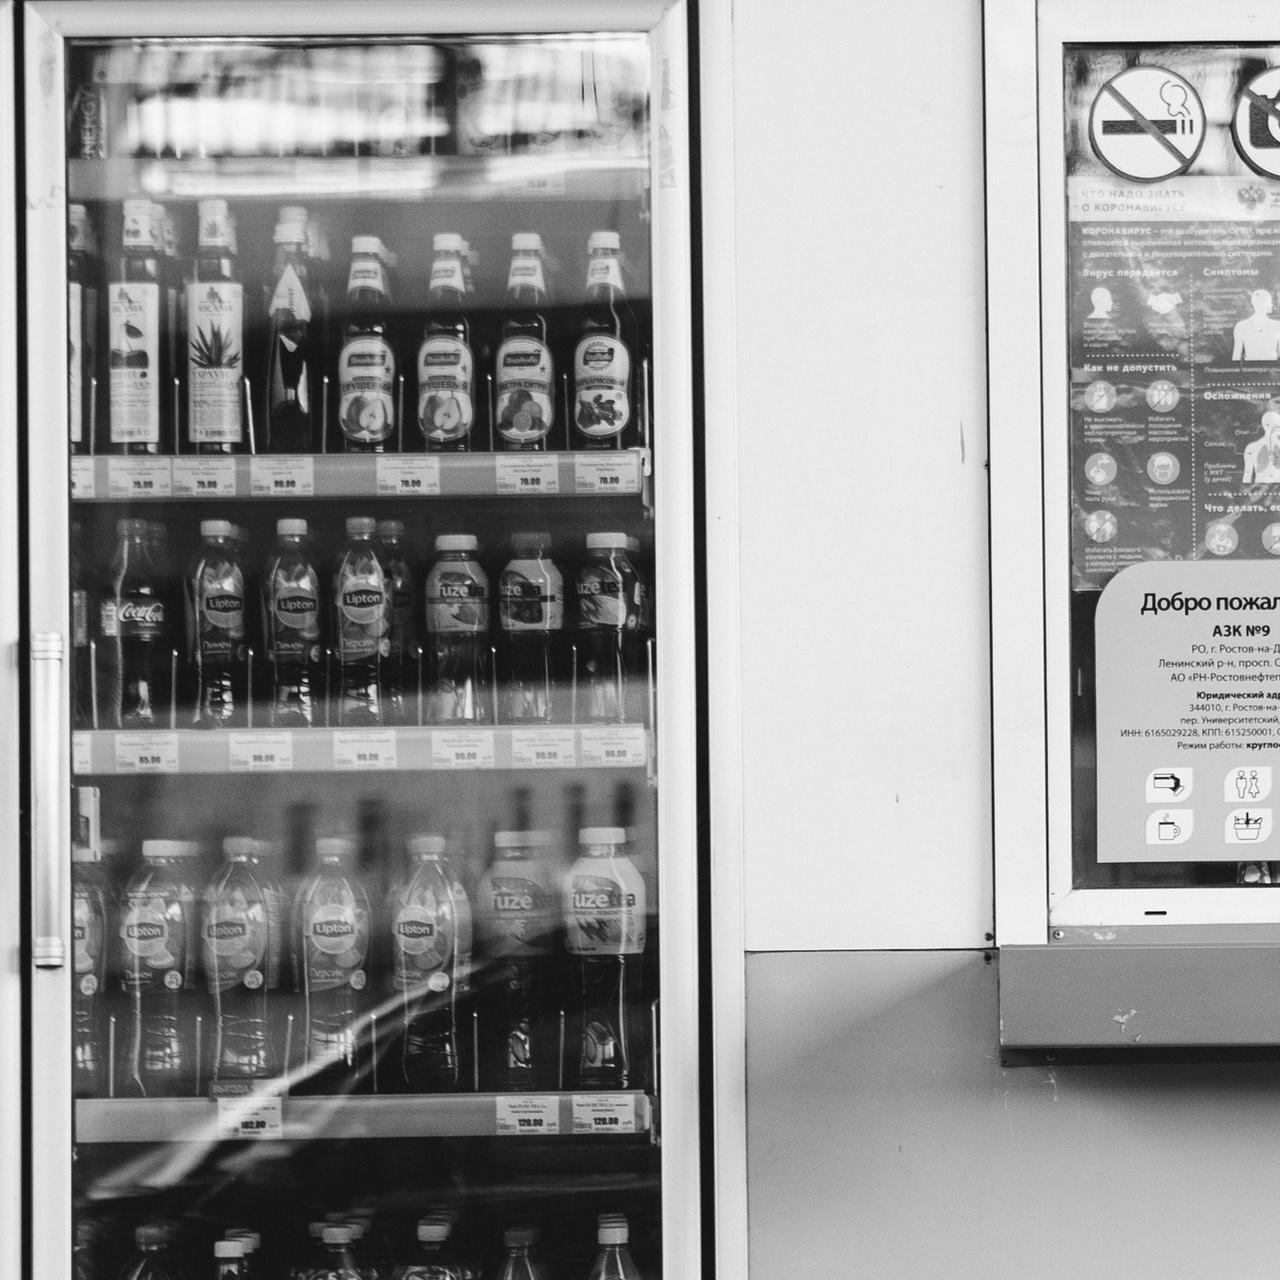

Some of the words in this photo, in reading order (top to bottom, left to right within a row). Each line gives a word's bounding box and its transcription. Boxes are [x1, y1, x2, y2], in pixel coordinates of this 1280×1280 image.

[1082, 268, 1115, 279] Вирус
[1117, 268, 1179, 279] передается
[1203, 267, 1259, 278] Симптомы
[1083, 364, 1104, 373] Как
[1122, 365, 1178, 374] допустить
[1203, 391, 1273, 401] Осложнения
[1205, 504, 1224, 512] Что
[1227, 504, 1268, 514] делать,
[345, 592, 381, 606] Lipton
[1141, 592, 1212, 616] Добро
[208, 599, 240, 611] Lipton
[281, 601, 314, 611] Lipton
[1213, 625, 1242, 637] АЗК
[1246, 625, 1271, 637] №9
[1192, 645, 1209, 654] РО,
[1158, 659, 1215, 668] Ленинский
[1217, 661, 1236, 669] р-н,
[1239, 660, 1272, 669] просп.
[1171, 673, 1186, 682] АО
[1197, 691, 1264, 701] Юридический
[1190, 704, 1223, 712] 344010,
[1180, 716, 1200, 725] пер.
[1201, 716, 1280, 725] Университетский,
[1145, 729, 1200, 737] 6165029228,
[1202, 728, 1223, 736] КПП:
[1225, 728, 1276, 737] 615250001,
[1209, 741, 1244, 750] работы:
[315, 922, 352, 935] Lipton
